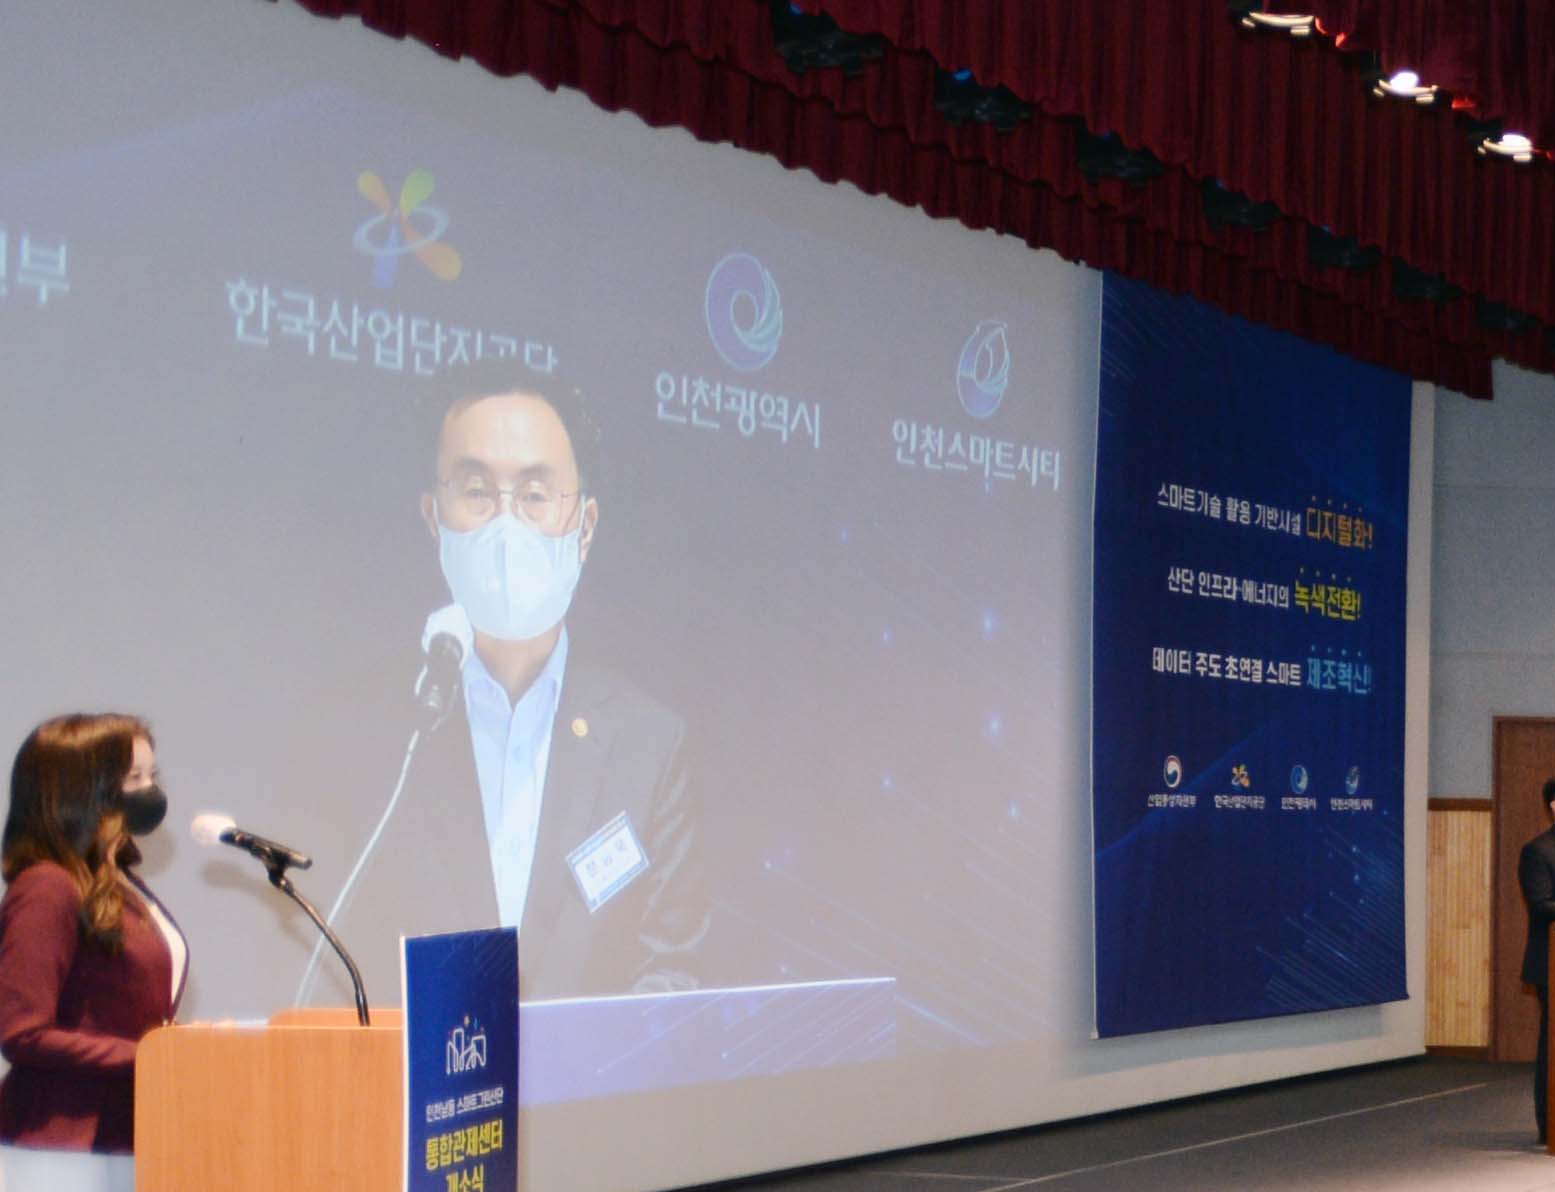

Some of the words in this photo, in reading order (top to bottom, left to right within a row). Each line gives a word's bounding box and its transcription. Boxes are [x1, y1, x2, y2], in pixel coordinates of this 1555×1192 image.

[656, 371, 821, 449] 인천광역시
[892, 418, 1061, 491] 인천스마트시티
[1226, 497, 1250, 525] 활용
[1255, 504, 1301, 536] 기반시설
[1305, 507, 1374, 549] 디지털화!
[1168, 566, 1194, 594] 산단
[1294, 580, 1361, 621] 녹색전환!
[1152, 647, 1192, 675] 데이터
[1195, 651, 1222, 678] 주도
[1225, 655, 1263, 683] 초연결
[1266, 659, 1302, 687] 스마트
[1306, 657, 1373, 694] 제조혁신!
[426, 1119, 503, 1171] 통합관제센터
